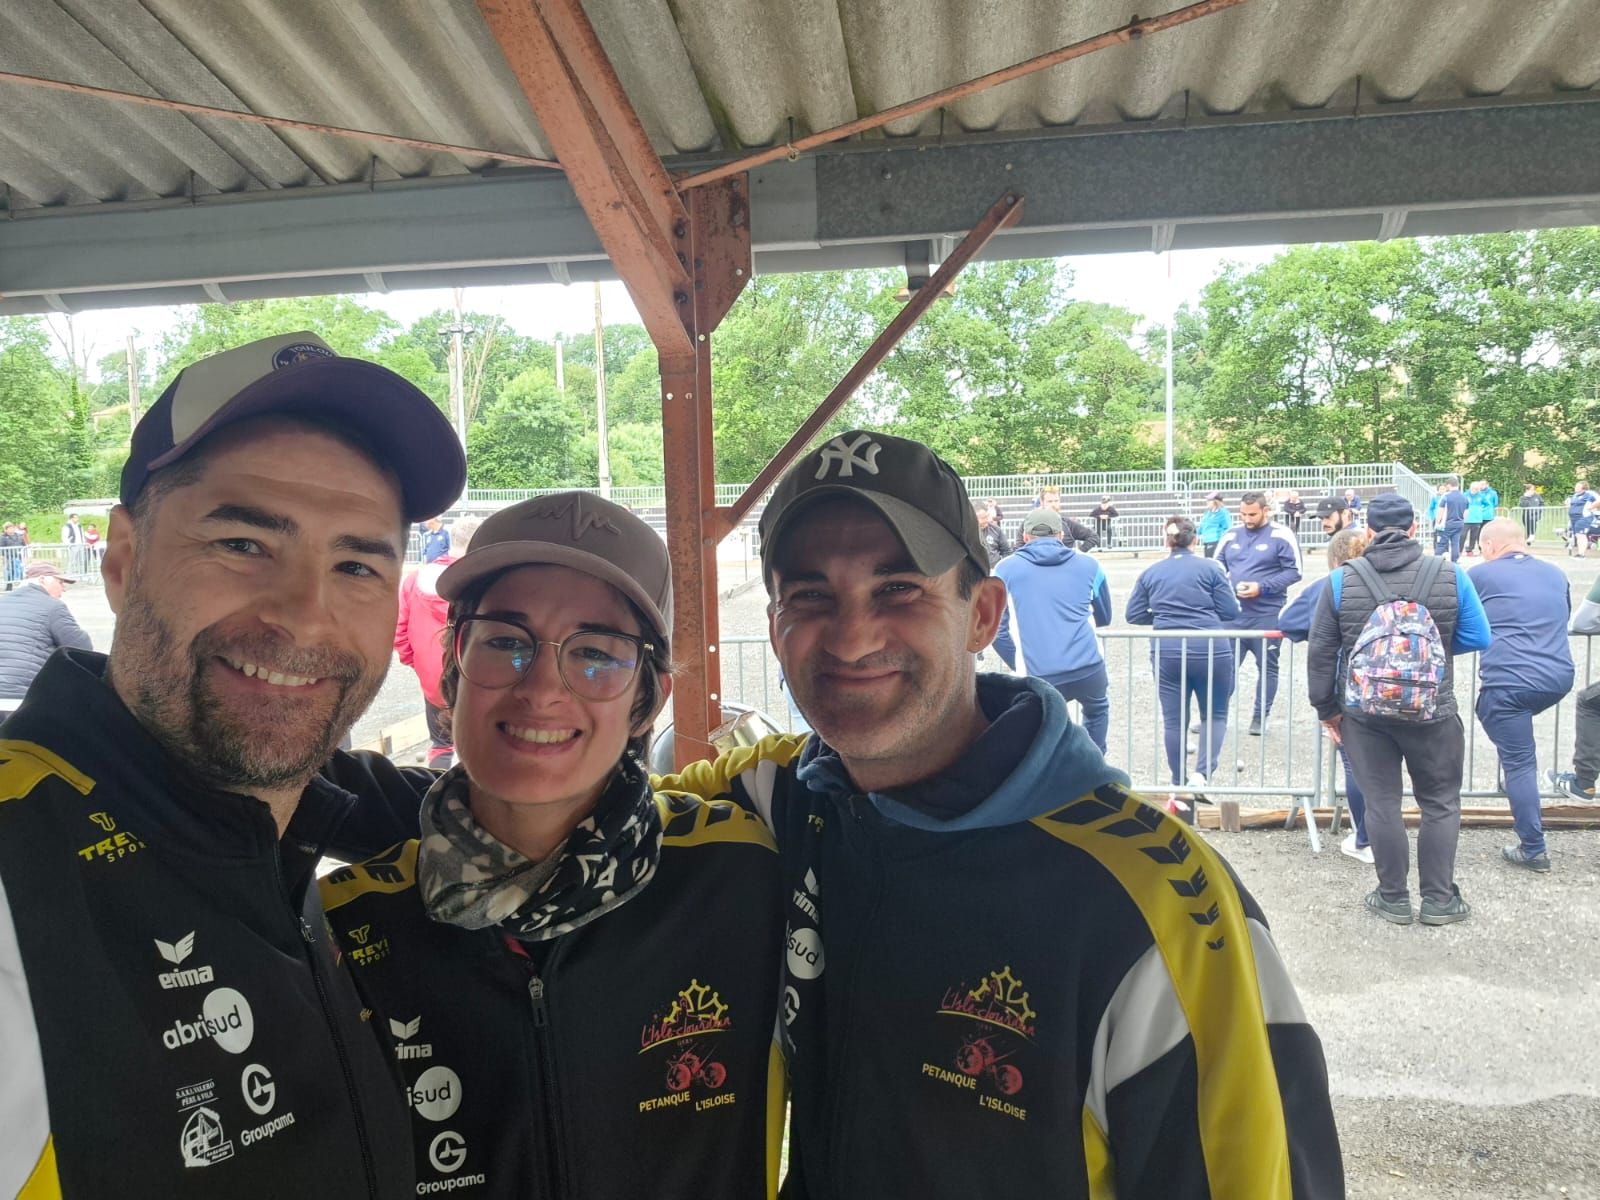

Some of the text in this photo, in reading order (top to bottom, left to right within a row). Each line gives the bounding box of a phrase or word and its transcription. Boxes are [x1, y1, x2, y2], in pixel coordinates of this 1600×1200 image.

[814, 433, 882, 480] NY
[348, 938, 389, 960] REVI
[158, 965, 214, 989] erima
[163, 1004, 242, 1050] abrisud
[639, 1091, 736, 1113] PETANQUE L'ISLOISE
[921, 1063, 1026, 1121] PETANQUE L'ISLOISE
[240, 1112, 296, 1146] Groupama
[416, 1173, 486, 1195] Groupama
